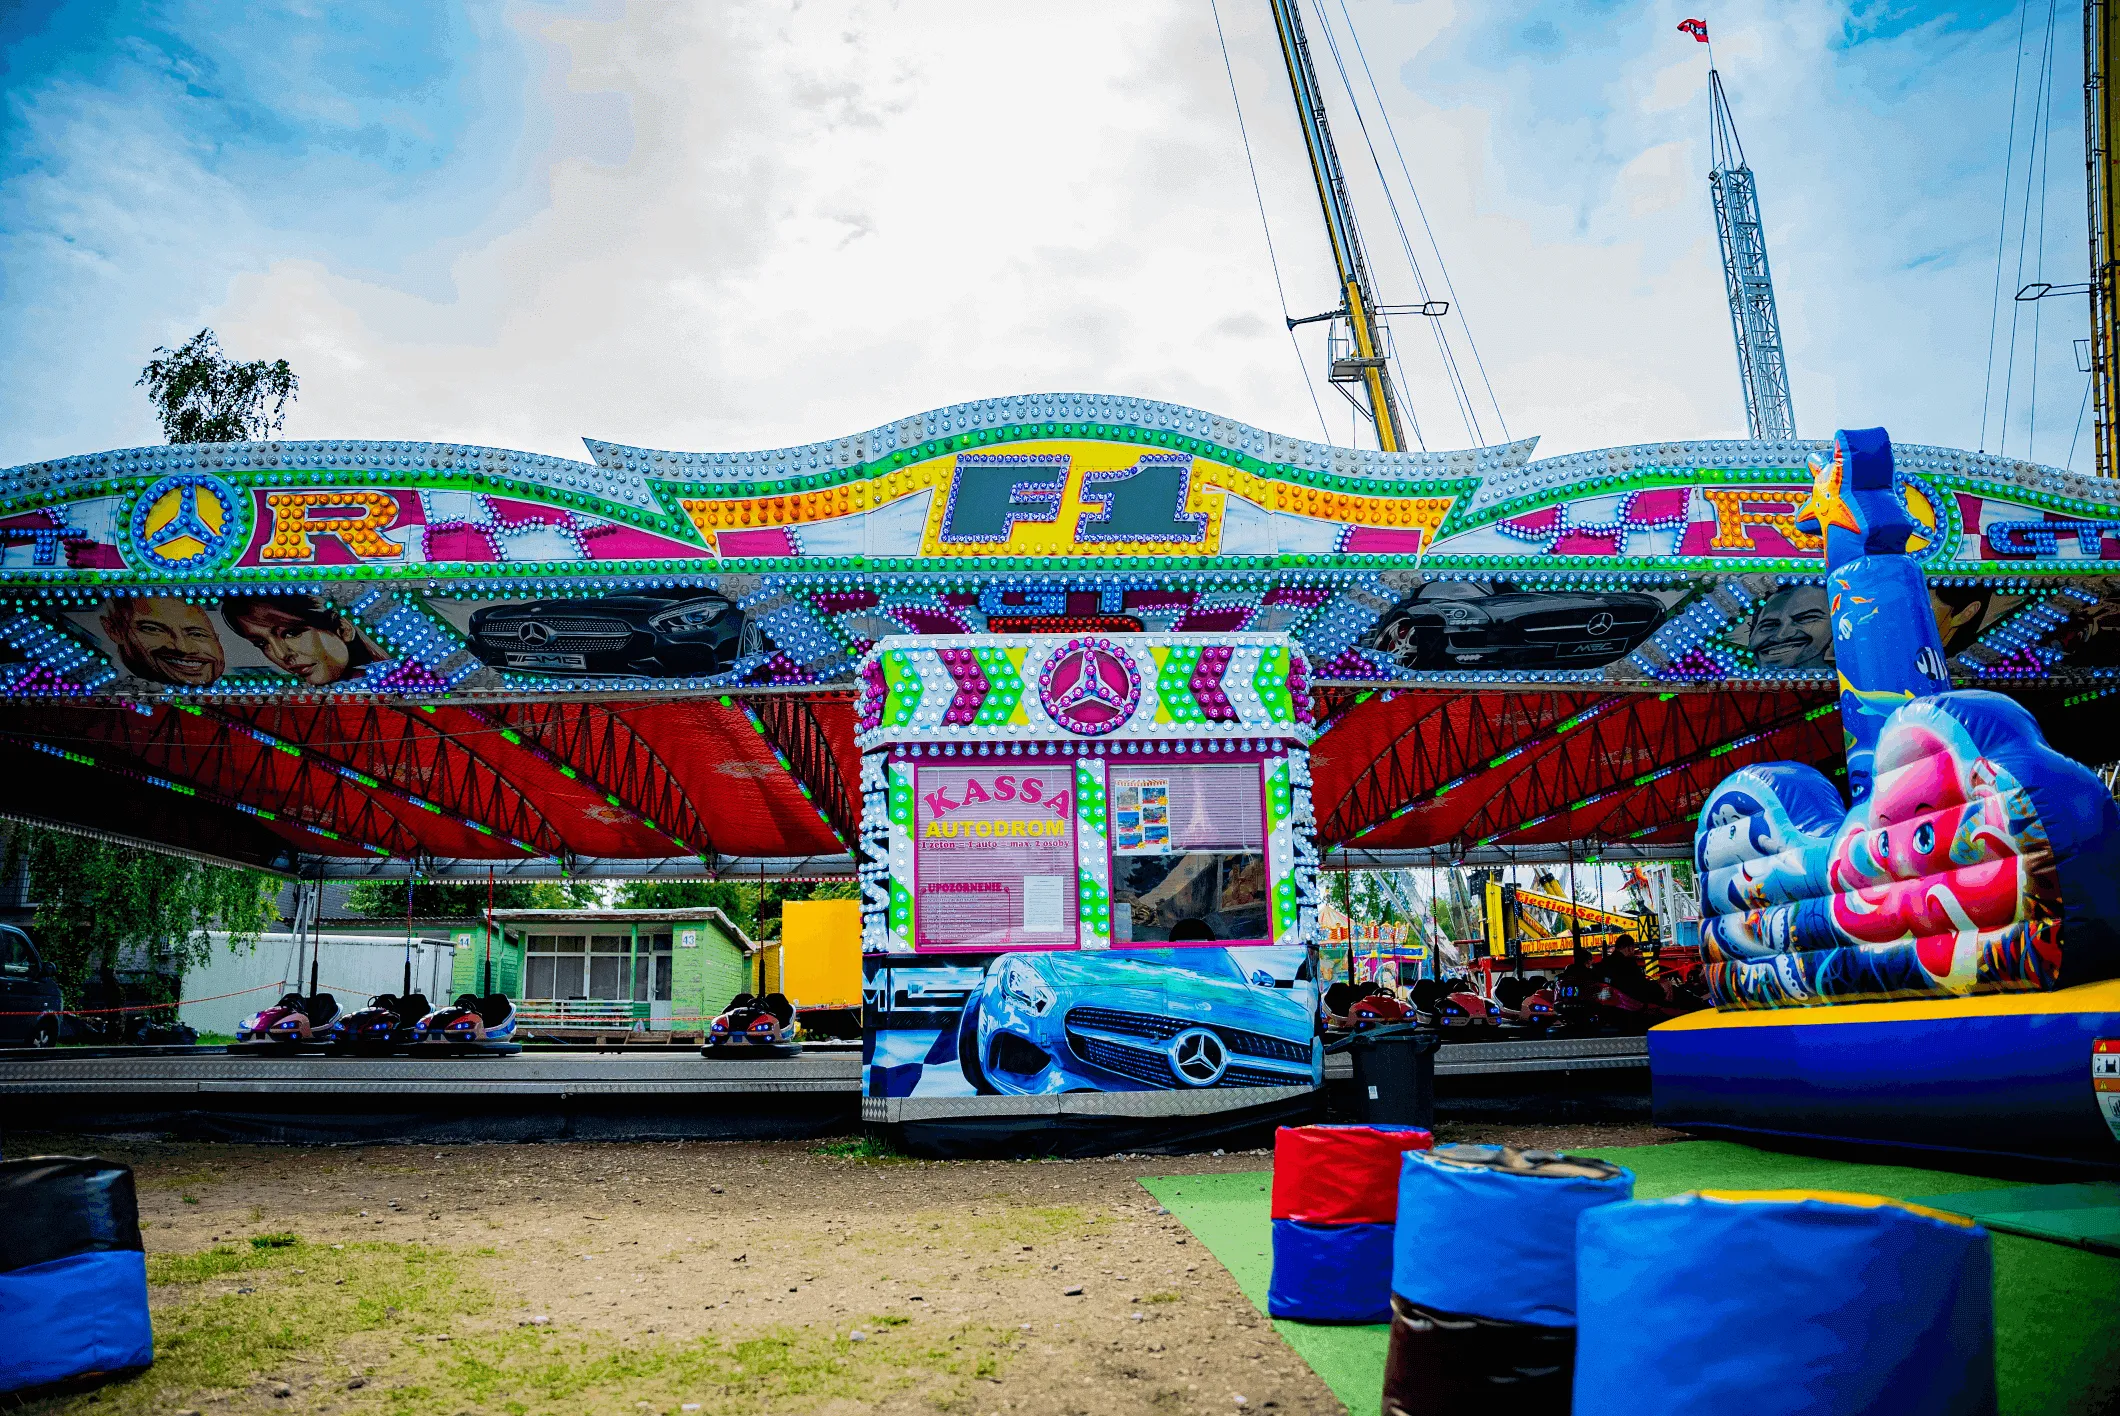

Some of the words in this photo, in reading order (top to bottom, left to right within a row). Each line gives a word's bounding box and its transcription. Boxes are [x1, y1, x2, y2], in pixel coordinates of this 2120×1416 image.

[939, 454, 1209, 543] F1
[259, 491, 405, 562] R
[923, 775, 1071, 820] KASSA
[925, 820, 1065, 839] AUTODROM
[1043, 839, 1070, 849] osoby
[683, 935, 695, 945] 43
